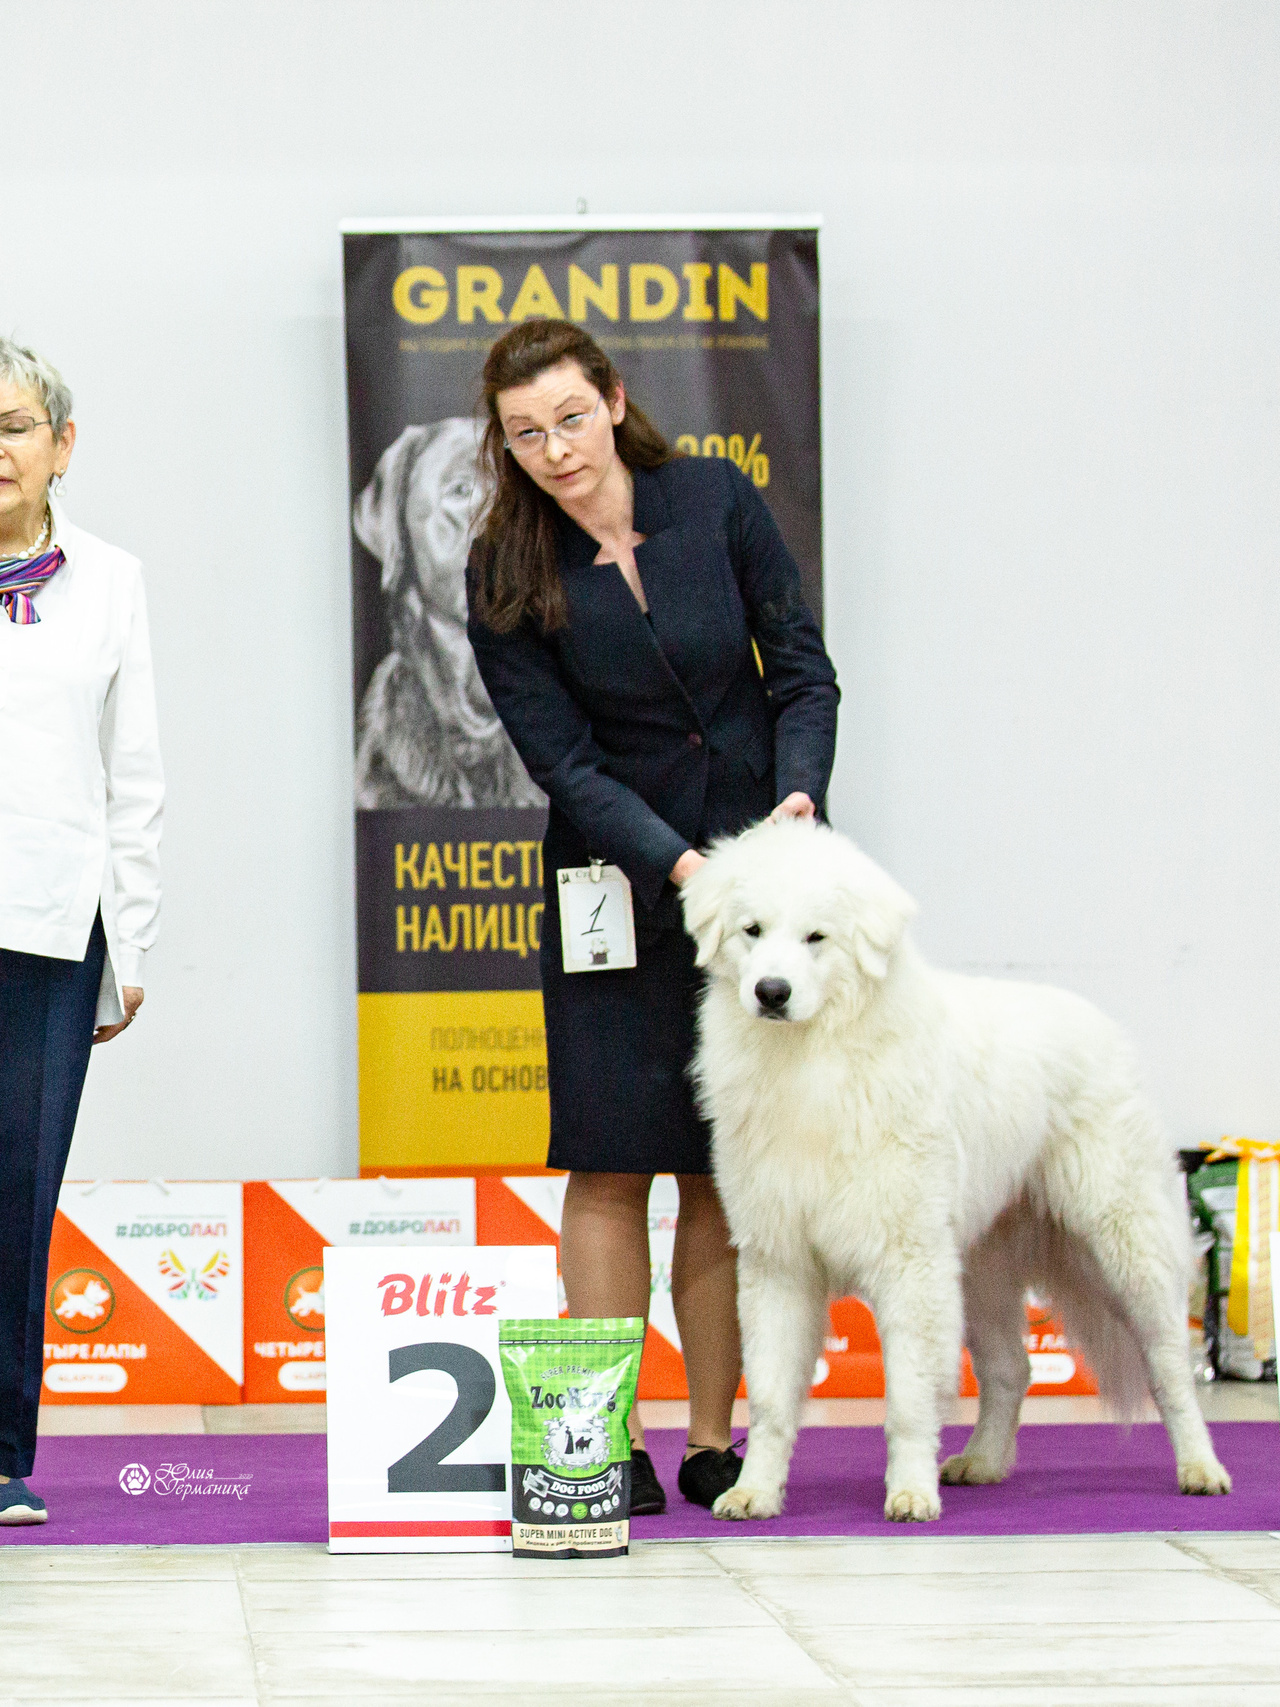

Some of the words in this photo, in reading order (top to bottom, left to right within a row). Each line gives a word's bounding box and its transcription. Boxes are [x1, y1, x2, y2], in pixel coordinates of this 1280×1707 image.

[392, 262, 769, 324] GRANDIN
[581, 893, 607, 935] 1
[432, 1066, 463, 1092] НА
[116, 1222, 227, 1239] #ДОБРОЛАП
[349, 1219, 461, 1235] #ДОБРОЛАП
[377, 1271, 499, 1317] Blitz
[43, 1343, 89, 1359] ТЫРЕ
[91, 1343, 147, 1359] ЛАПЫ
[387, 1341, 507, 1493] 2
[551, 1481, 577, 1494] DOG
[577, 1480, 606, 1495] FOOD
[520, 1528, 545, 1538] SUPER
[547, 1529, 565, 1539] MINI
[568, 1528, 597, 1538] ACTIVE
[599, 1527, 613, 1537] DOG
